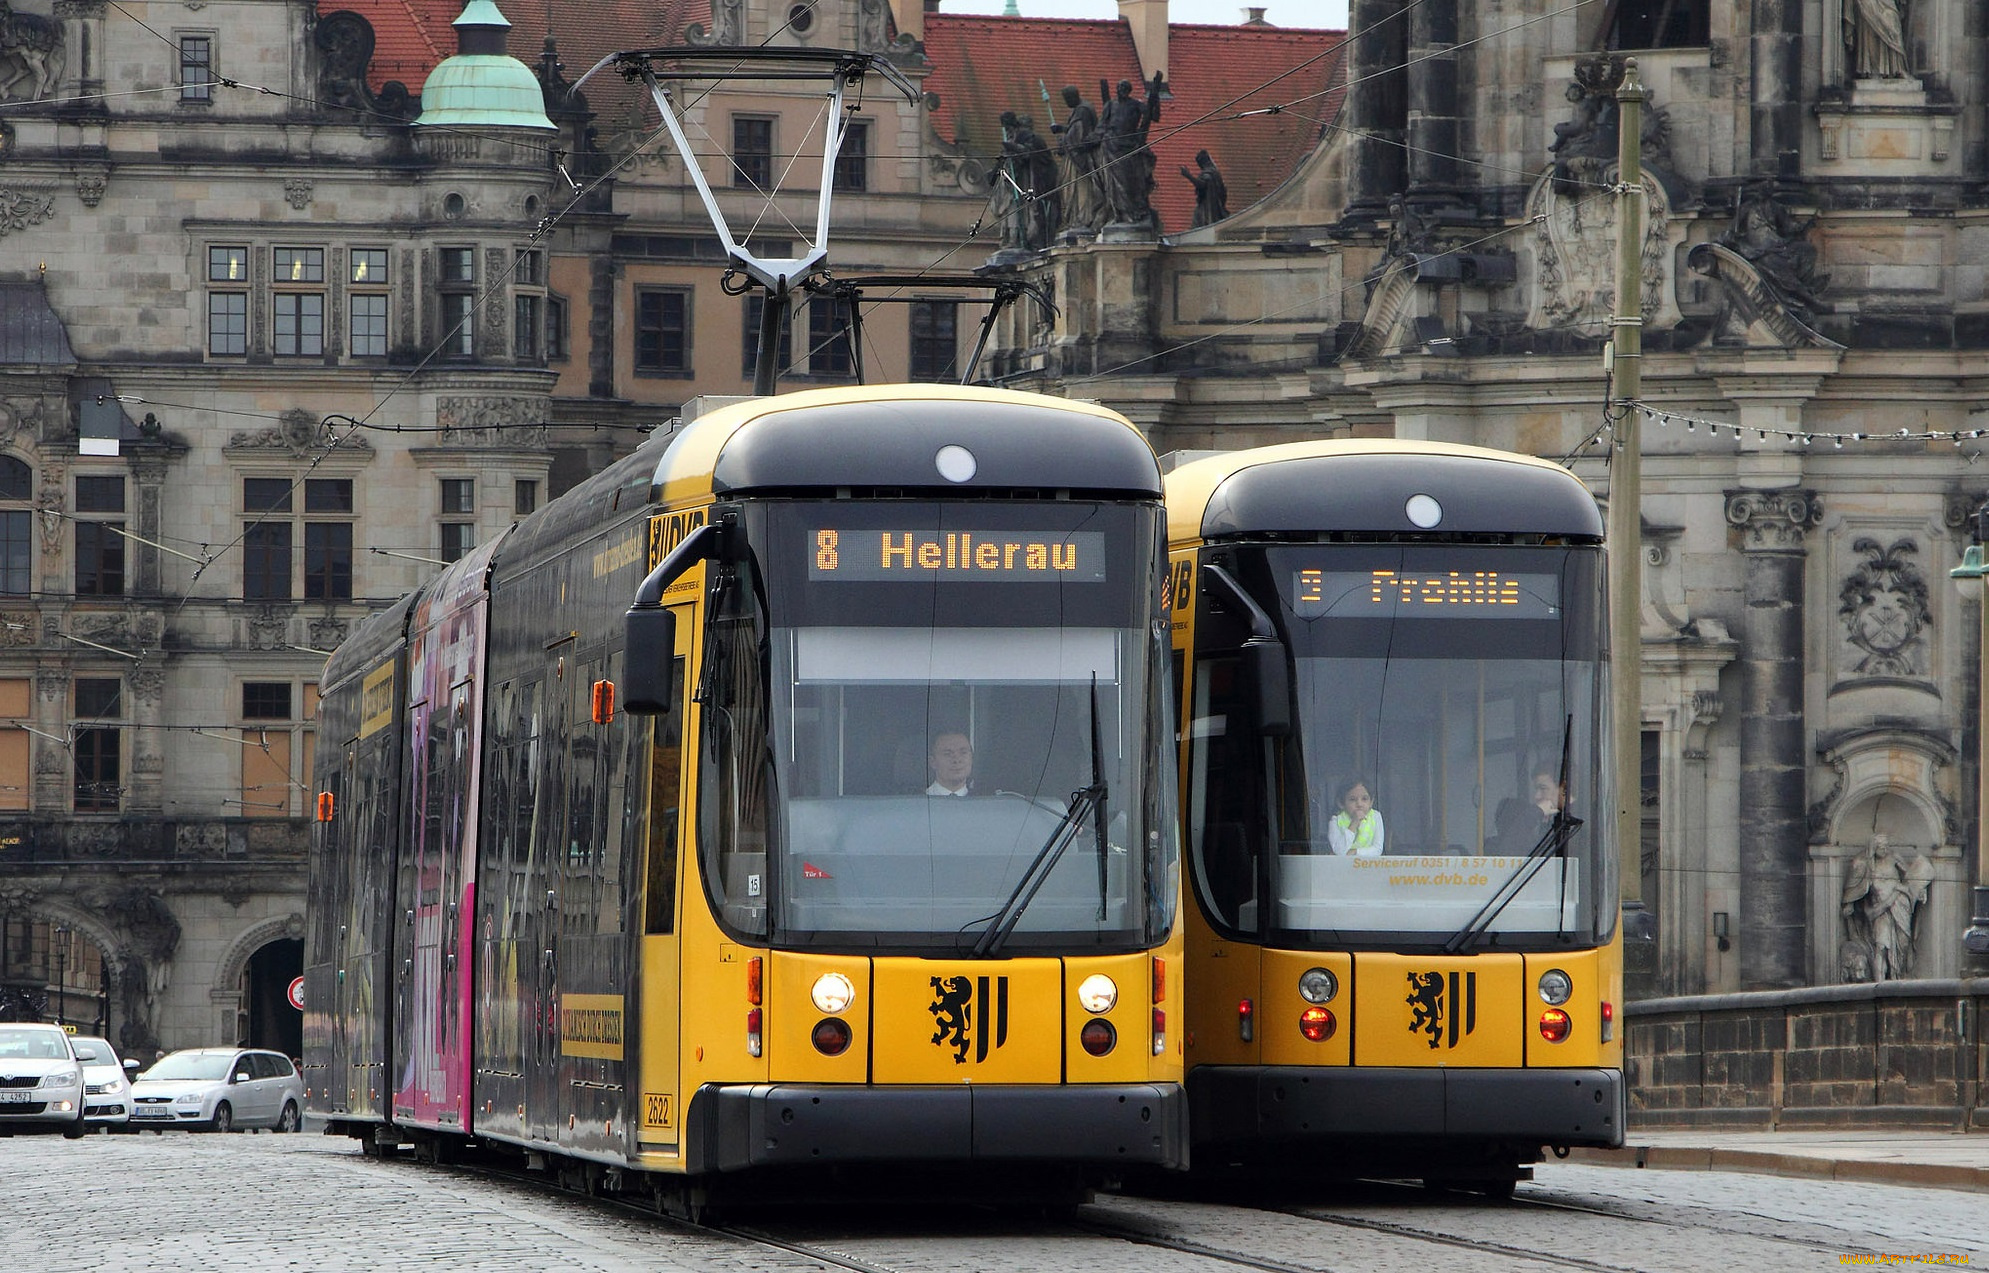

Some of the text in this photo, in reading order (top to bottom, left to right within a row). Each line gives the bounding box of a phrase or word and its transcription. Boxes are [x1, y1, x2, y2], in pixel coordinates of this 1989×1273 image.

[816, 529, 1076, 570] 8 Hellerau
[1353, 857, 1419, 869] Serviceruf
[1421, 857, 1450, 868] 0351
[1461, 857, 1470, 868] 8
[750, 878, 758, 892] 15
[1389, 871, 1488, 886] www.dvb.de
[648, 1096, 669, 1125] 2622
